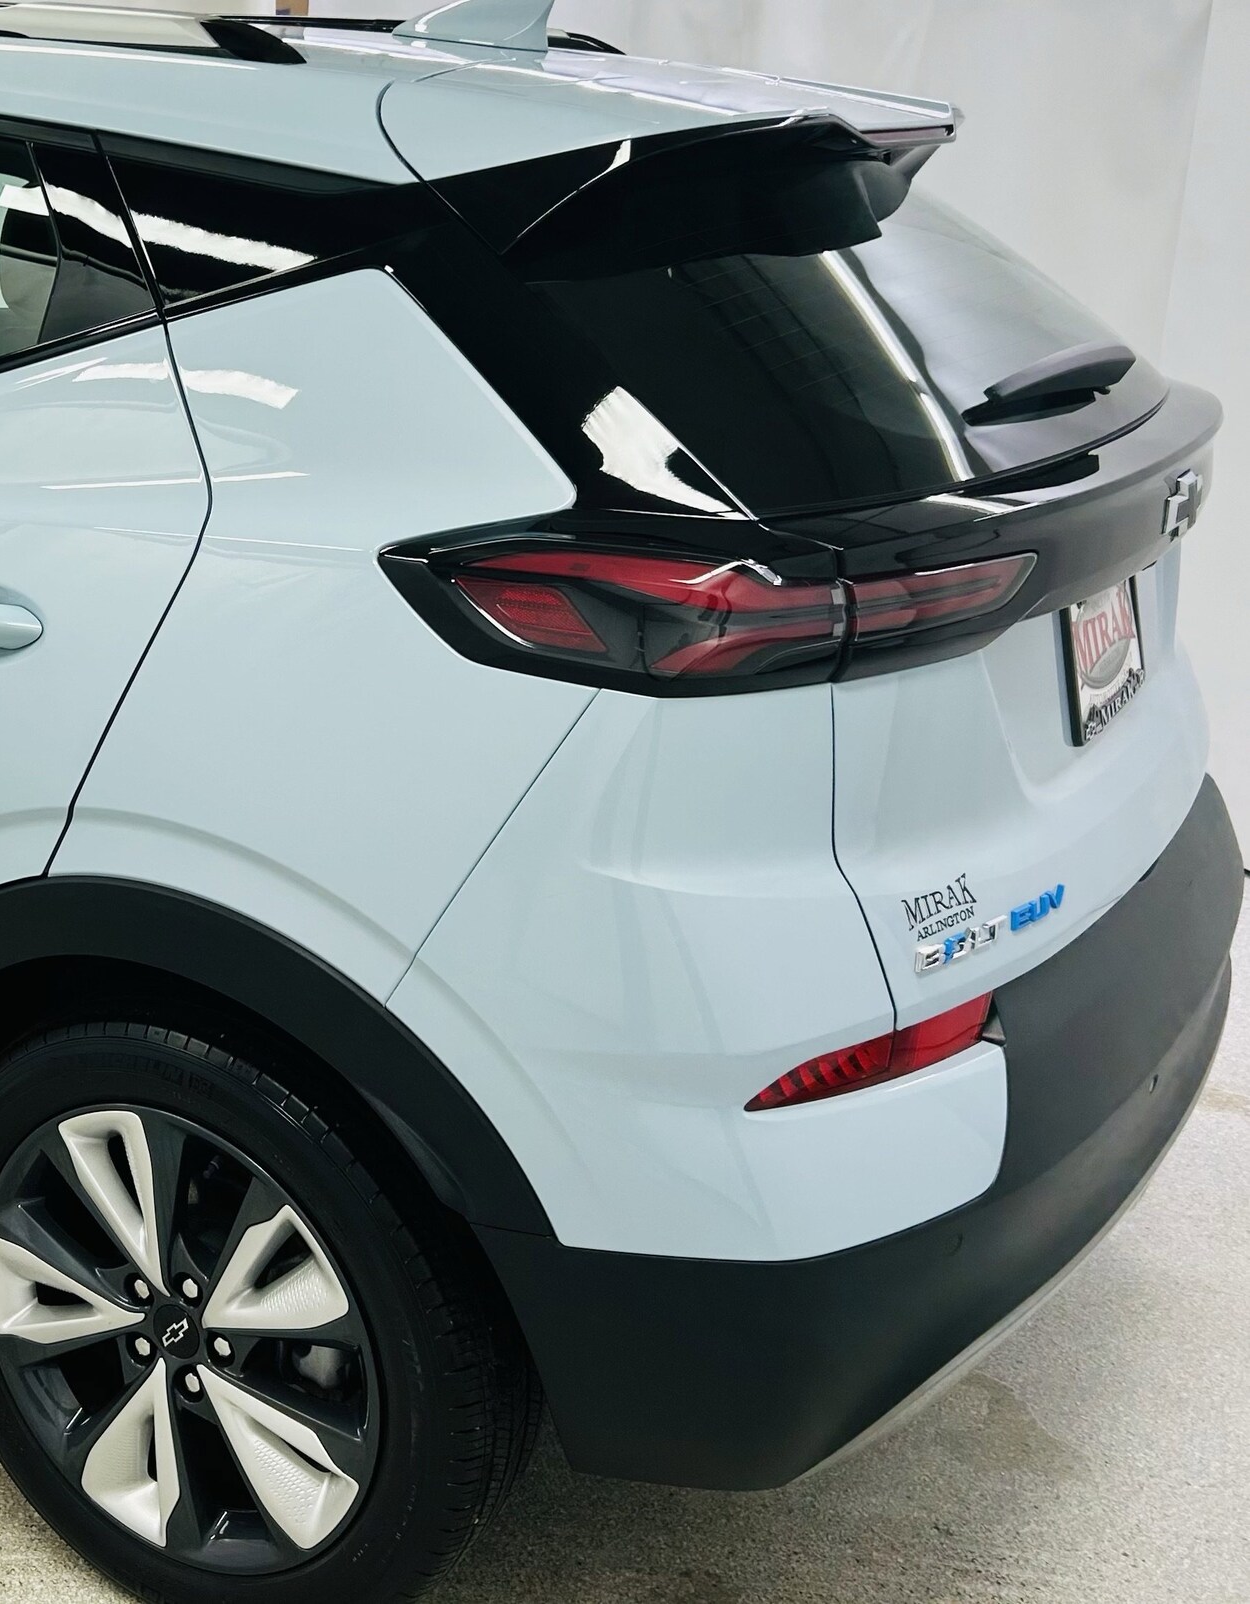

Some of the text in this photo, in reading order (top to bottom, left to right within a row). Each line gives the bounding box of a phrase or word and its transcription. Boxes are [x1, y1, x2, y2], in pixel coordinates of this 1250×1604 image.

[1072, 588, 1136, 672] MIRAK
[1100, 683, 1136, 726] MIRAK
[901, 872, 977, 931] MIRAK
[915, 884, 1064, 973] BOLT EUV
[917, 906, 976, 942] ARLINGTON
